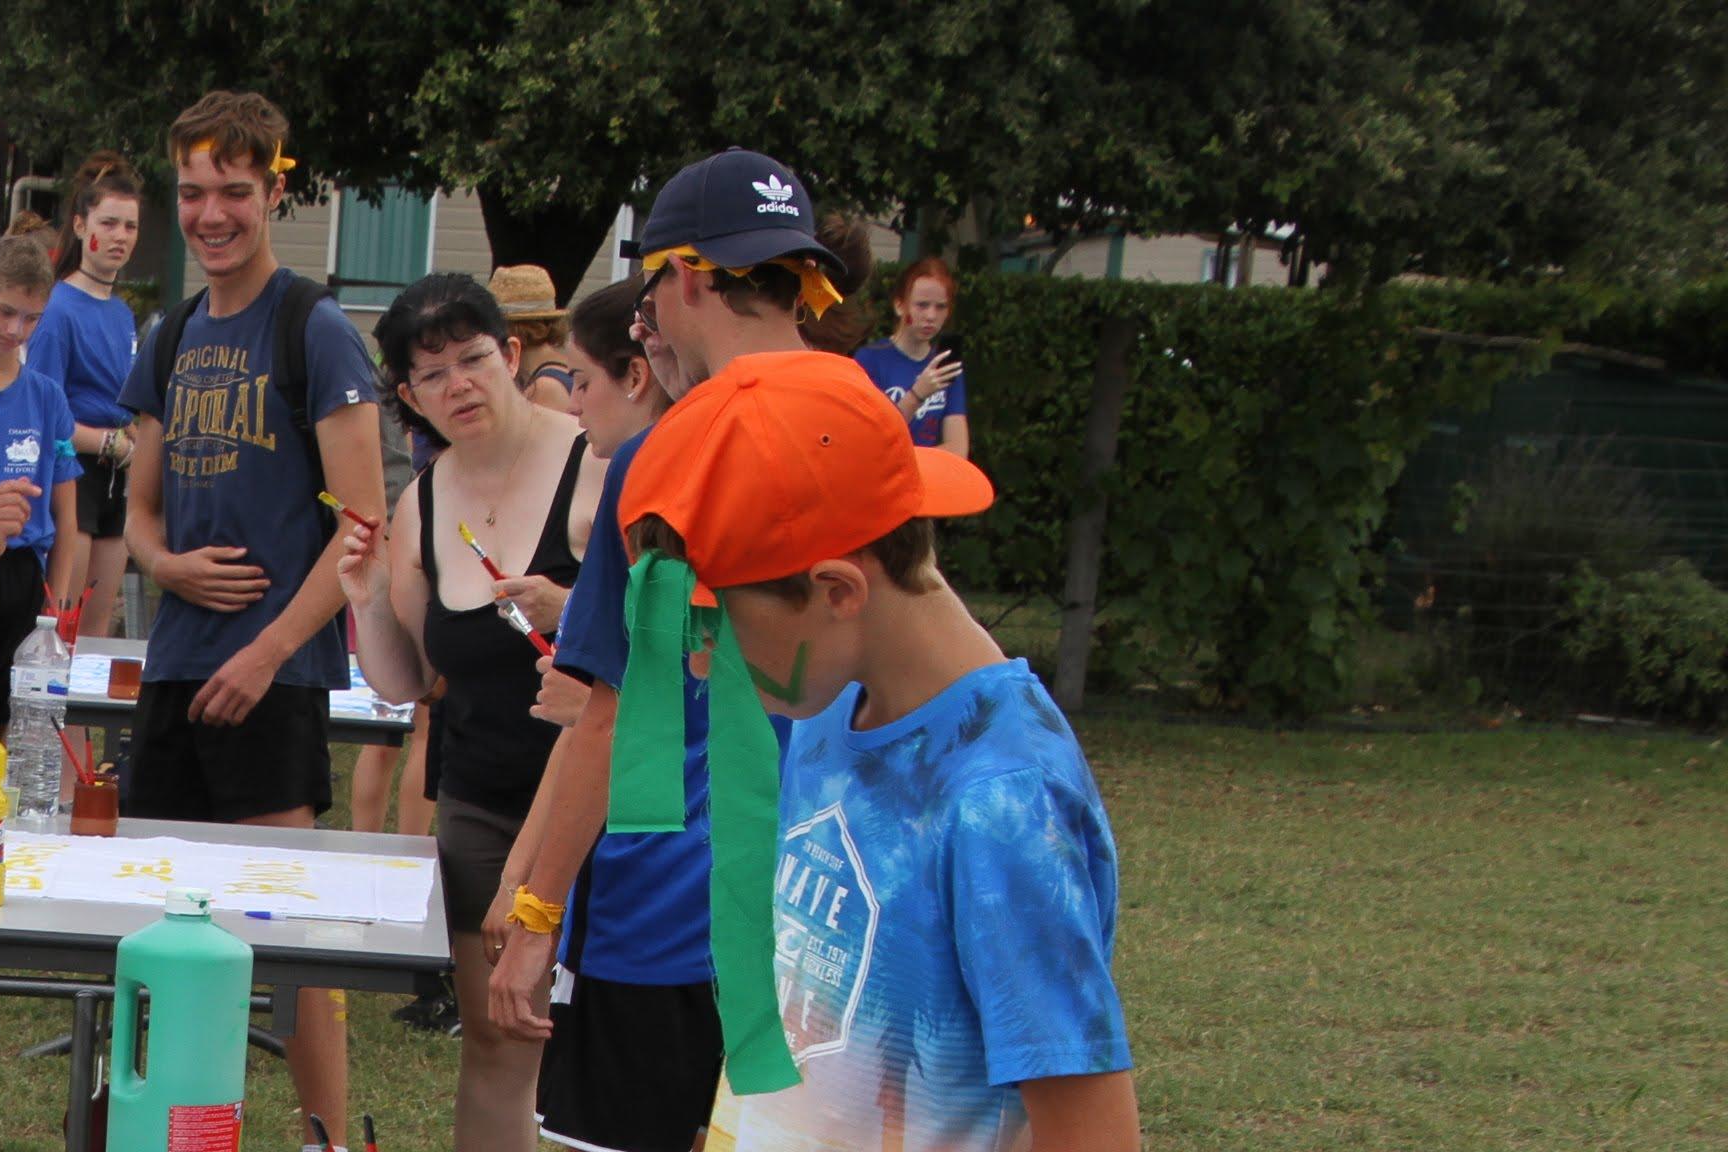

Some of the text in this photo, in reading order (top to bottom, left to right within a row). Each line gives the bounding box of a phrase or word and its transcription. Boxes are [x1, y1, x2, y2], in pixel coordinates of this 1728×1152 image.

[757, 201, 799, 217] adidas
[175, 345, 250, 375] ORIGINAL
[165, 374, 275, 451] APORAL
